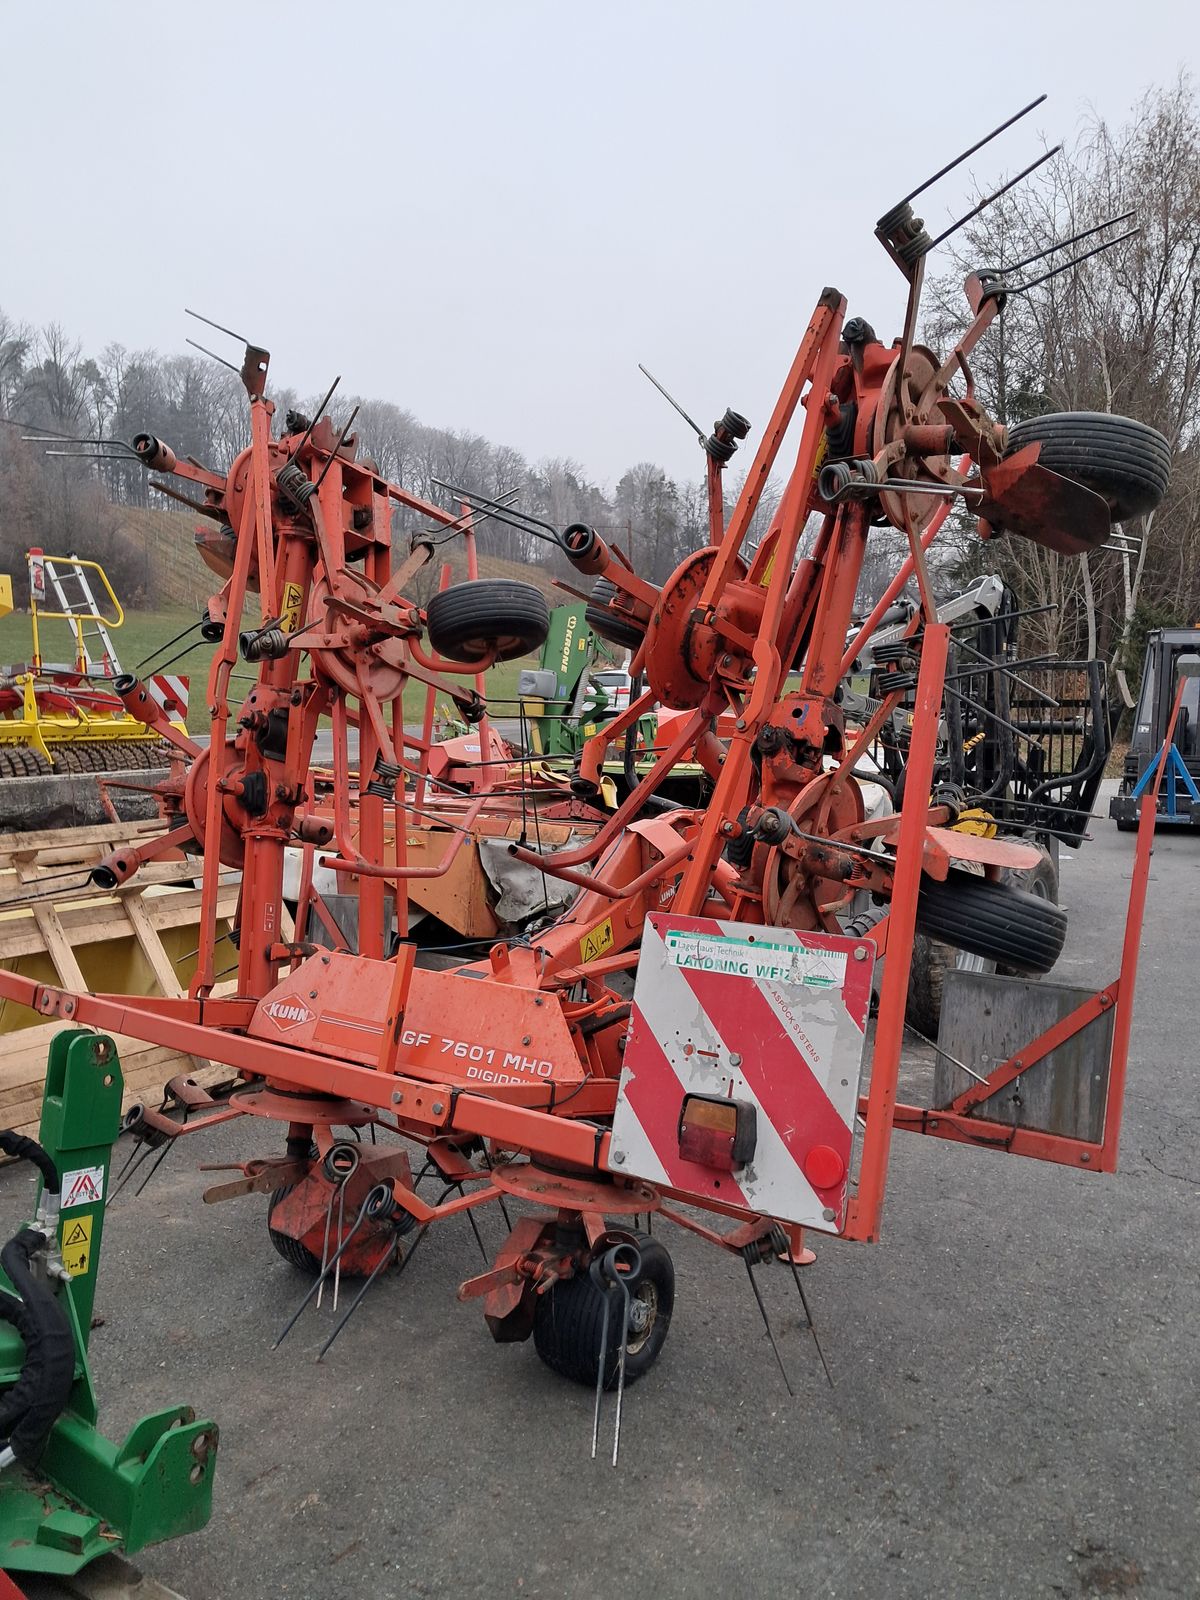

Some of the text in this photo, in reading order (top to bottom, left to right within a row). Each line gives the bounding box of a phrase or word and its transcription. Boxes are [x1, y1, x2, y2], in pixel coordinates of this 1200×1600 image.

[560, 629, 573, 673] KRONE
[676, 953, 748, 974] LANDRING
[269, 1002, 309, 1022] KUHN
[401, 1030, 553, 1077] GF 7601 MHO
[793, 1023, 821, 1062] SYSTEMS
